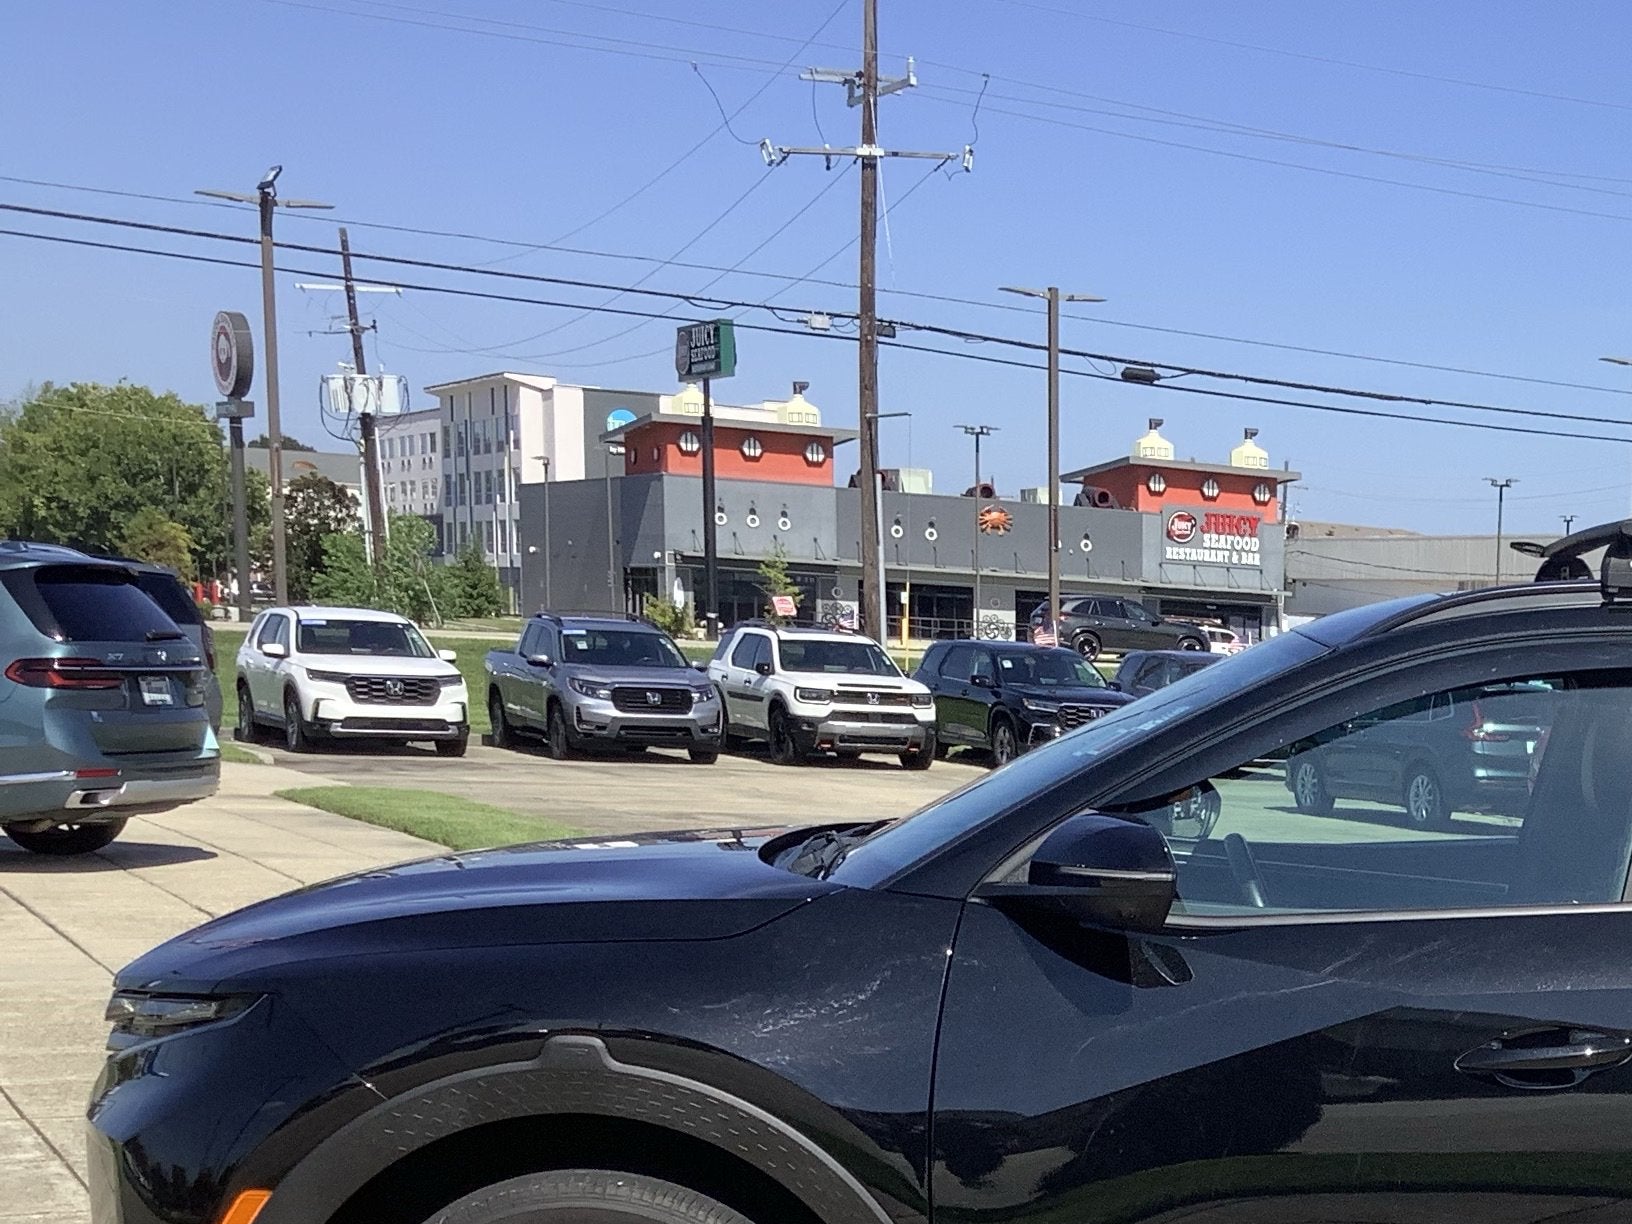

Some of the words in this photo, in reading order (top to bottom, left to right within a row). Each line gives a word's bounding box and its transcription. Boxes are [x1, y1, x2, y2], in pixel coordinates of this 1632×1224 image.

[690, 323, 715, 348] JUICY
[1200, 512, 1261, 537] JUICY
[1202, 533, 1260, 552] SEAFOOD
[1165, 546, 1230, 563] RESTAURANT
[1231, 551, 1239, 564] &
[1240, 552, 1261, 566] BAR
